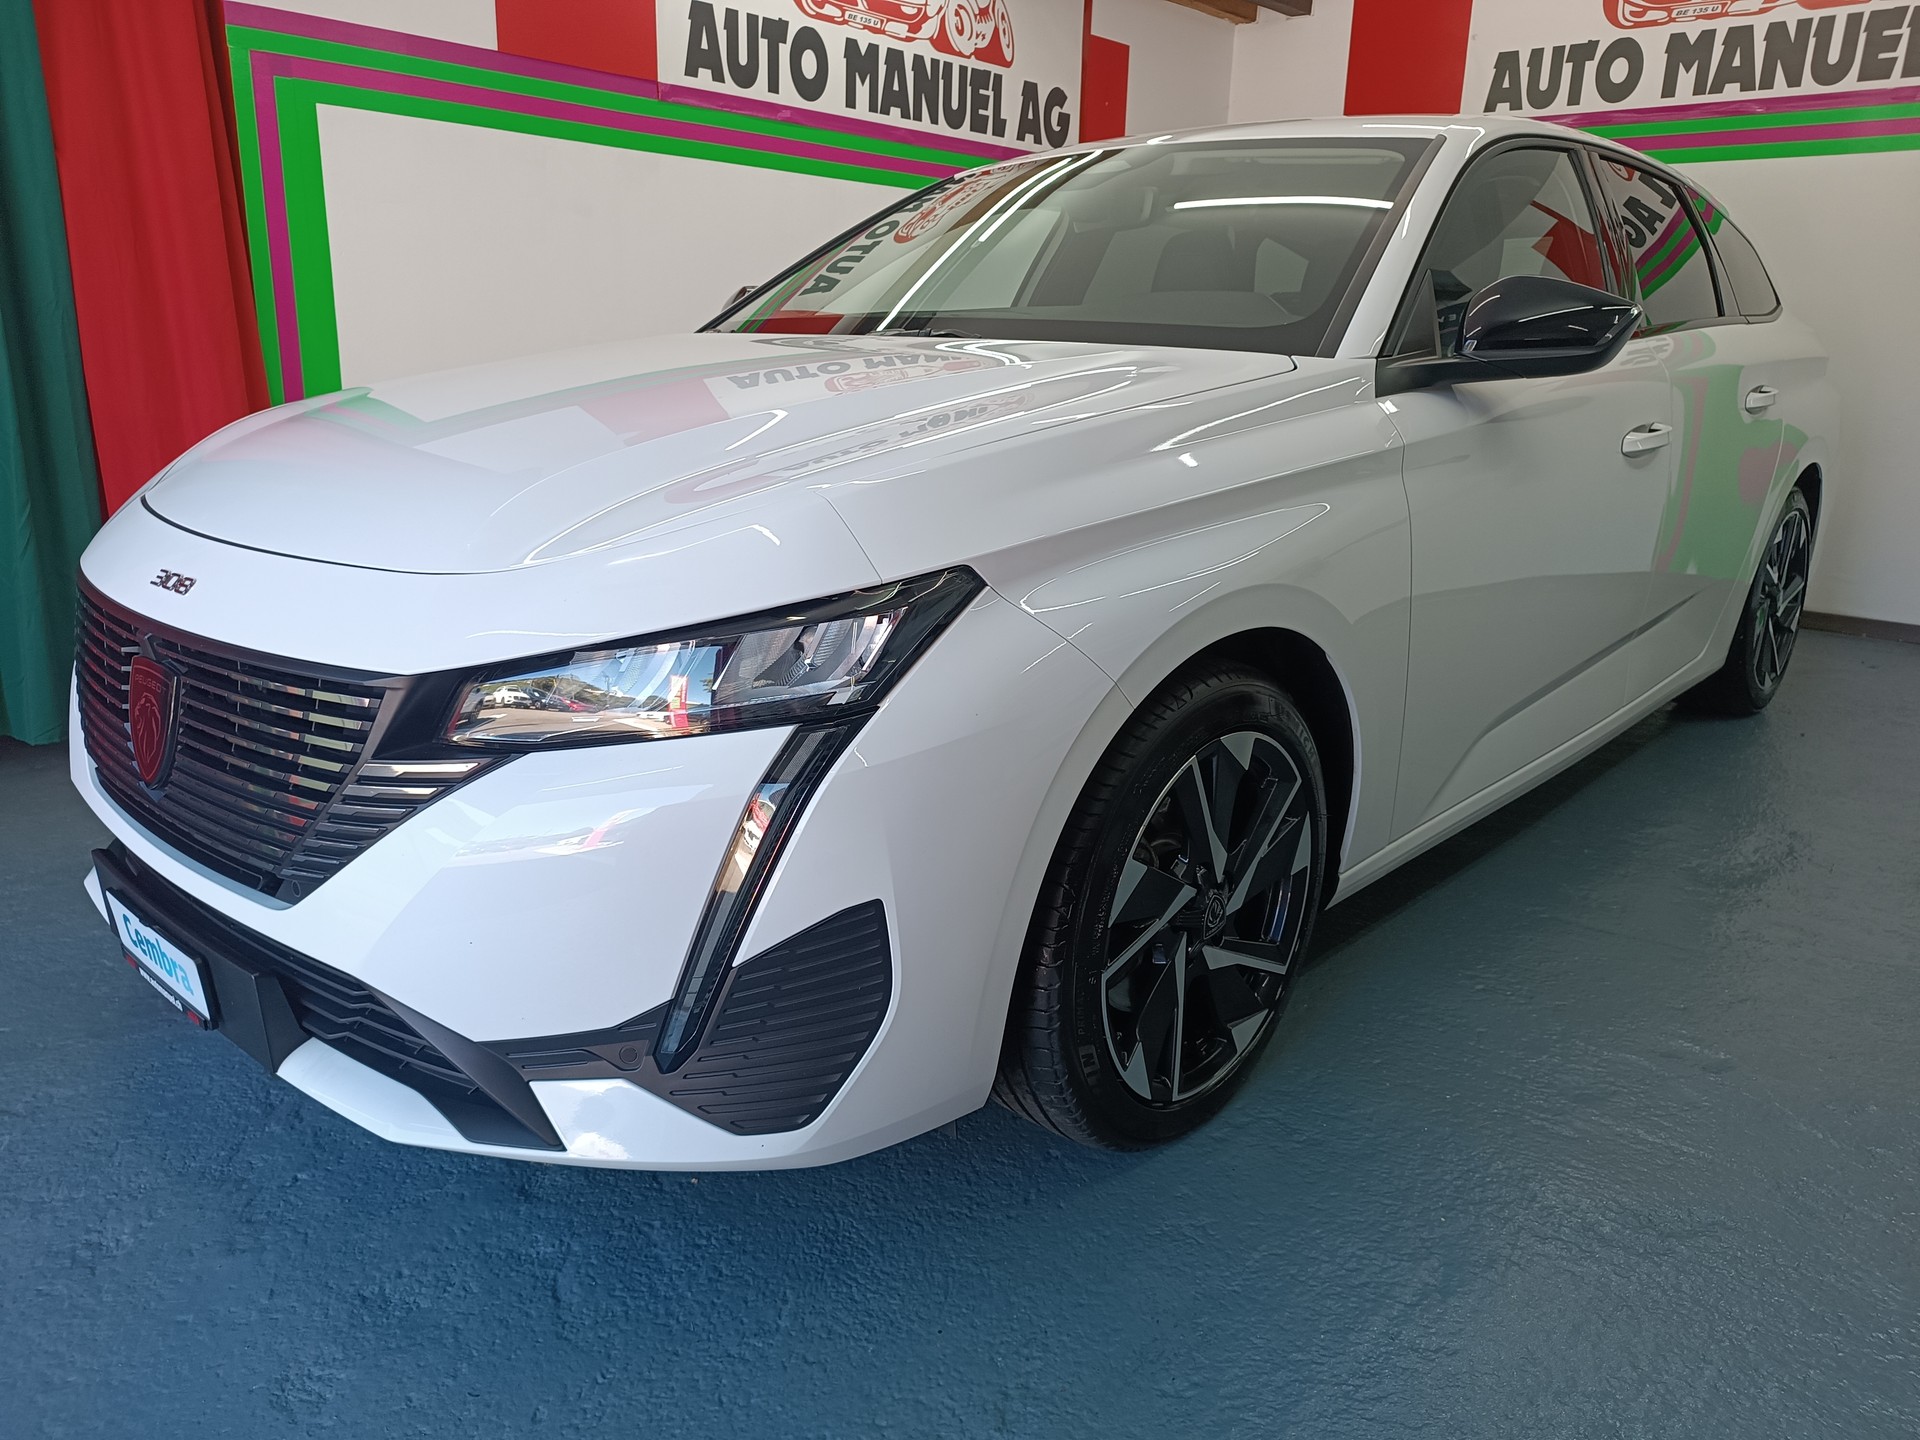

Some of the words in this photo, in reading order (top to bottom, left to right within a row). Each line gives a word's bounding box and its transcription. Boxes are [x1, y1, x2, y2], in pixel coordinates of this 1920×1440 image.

[1692, 6, 1709, 14] 135
[684, 0, 829, 102] AUTO
[843, 37, 1008, 139] MANUEL
[1016, 80, 1071, 149] AG
[1483, 36, 1644, 114] AUTO
[149, 568, 197, 595] 308
[135, 673, 167, 694] PEUGEOT
[122, 913, 195, 996] Cembra
